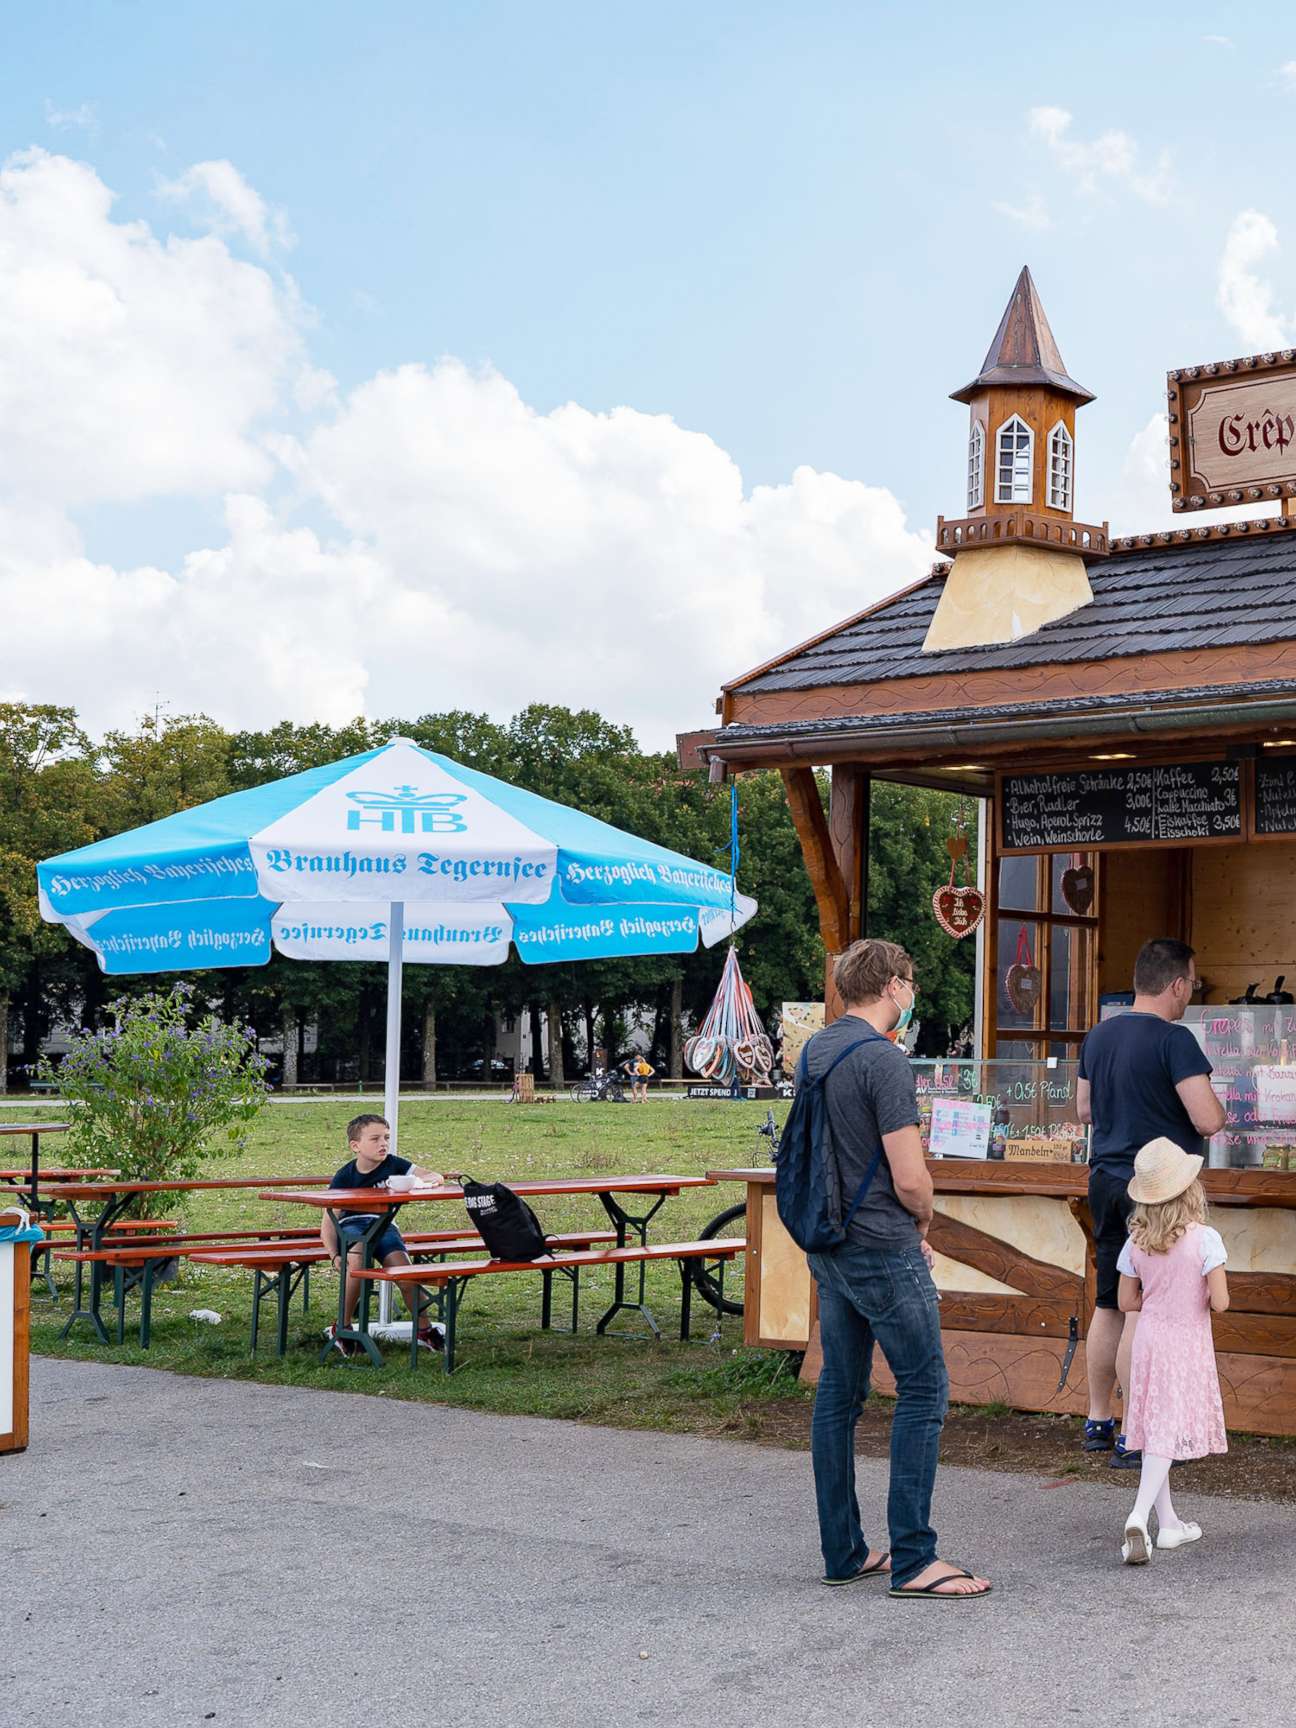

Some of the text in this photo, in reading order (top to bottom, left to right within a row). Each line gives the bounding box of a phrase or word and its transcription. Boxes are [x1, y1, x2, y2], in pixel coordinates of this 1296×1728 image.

[1155, 766, 1196, 789] Kaffee
[1036, 794, 1080, 813] Radler
[266, 849, 547, 884] Brauhaus Tegernsee
[565, 862, 657, 887] Herzoglich
[50, 868, 148, 896] Herzoglich
[1039, 1079, 1074, 1101] Pfand
[1008, 1144, 1050, 1157] Mandeln
